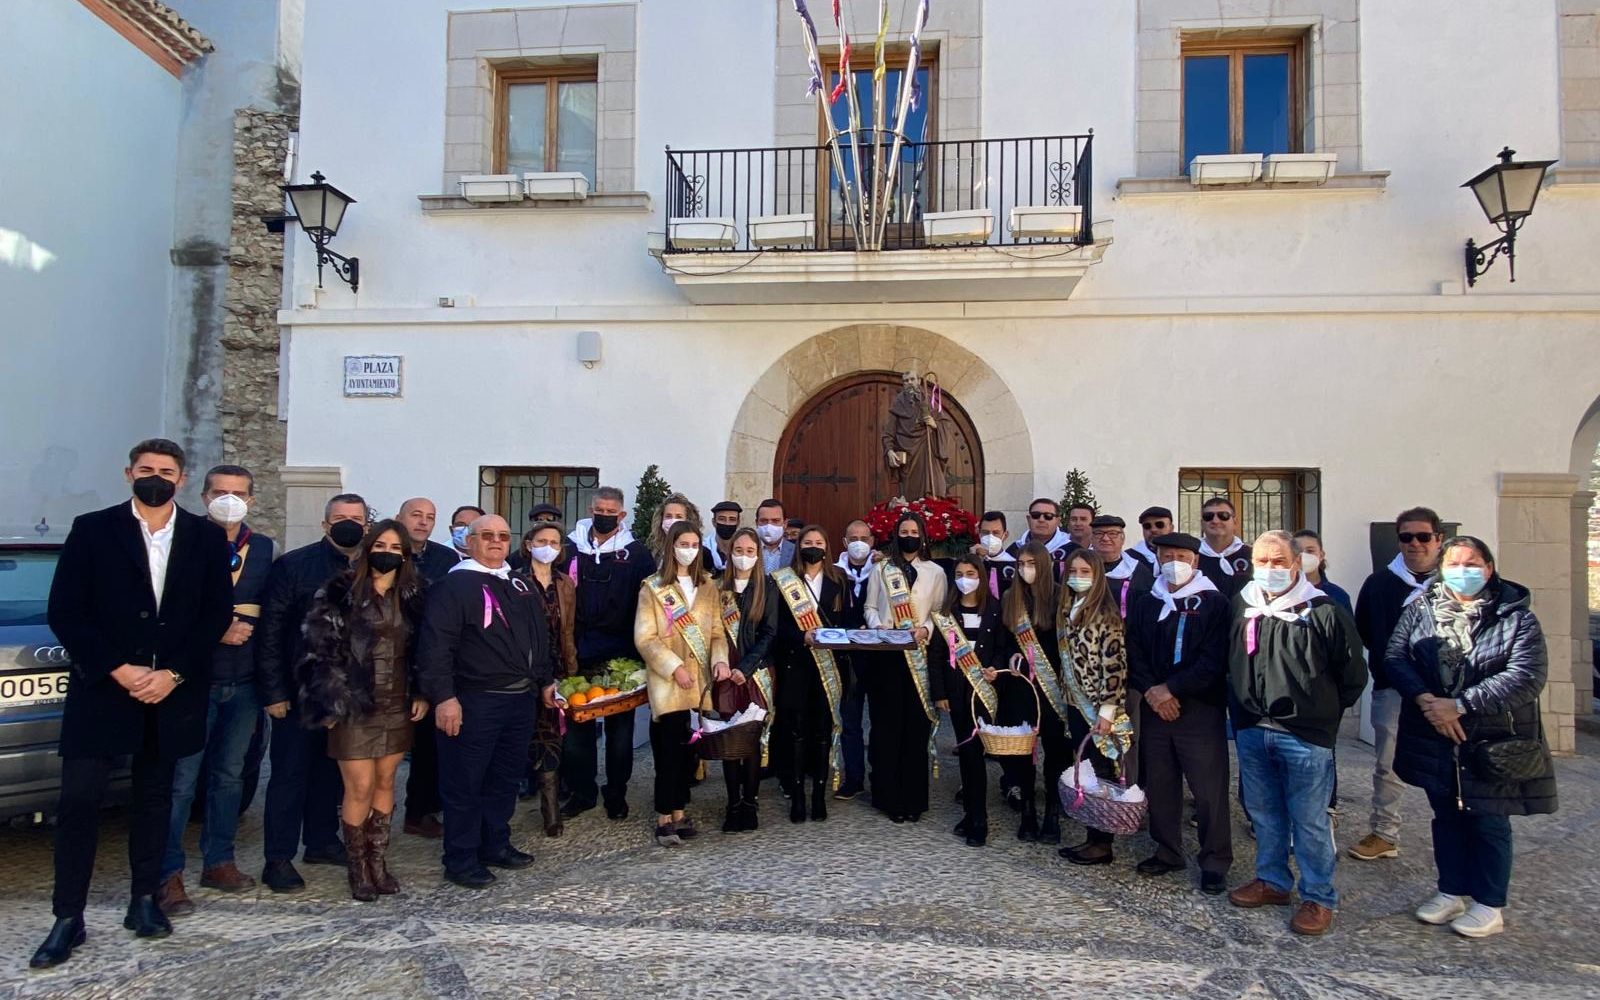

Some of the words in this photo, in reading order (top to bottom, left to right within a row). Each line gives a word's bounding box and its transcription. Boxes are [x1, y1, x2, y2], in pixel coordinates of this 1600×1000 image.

[364, 362, 393, 373] PLAZA
[349, 379, 396, 388] AYUNTAMIENTO
[1, 675, 69, 698] 0056
